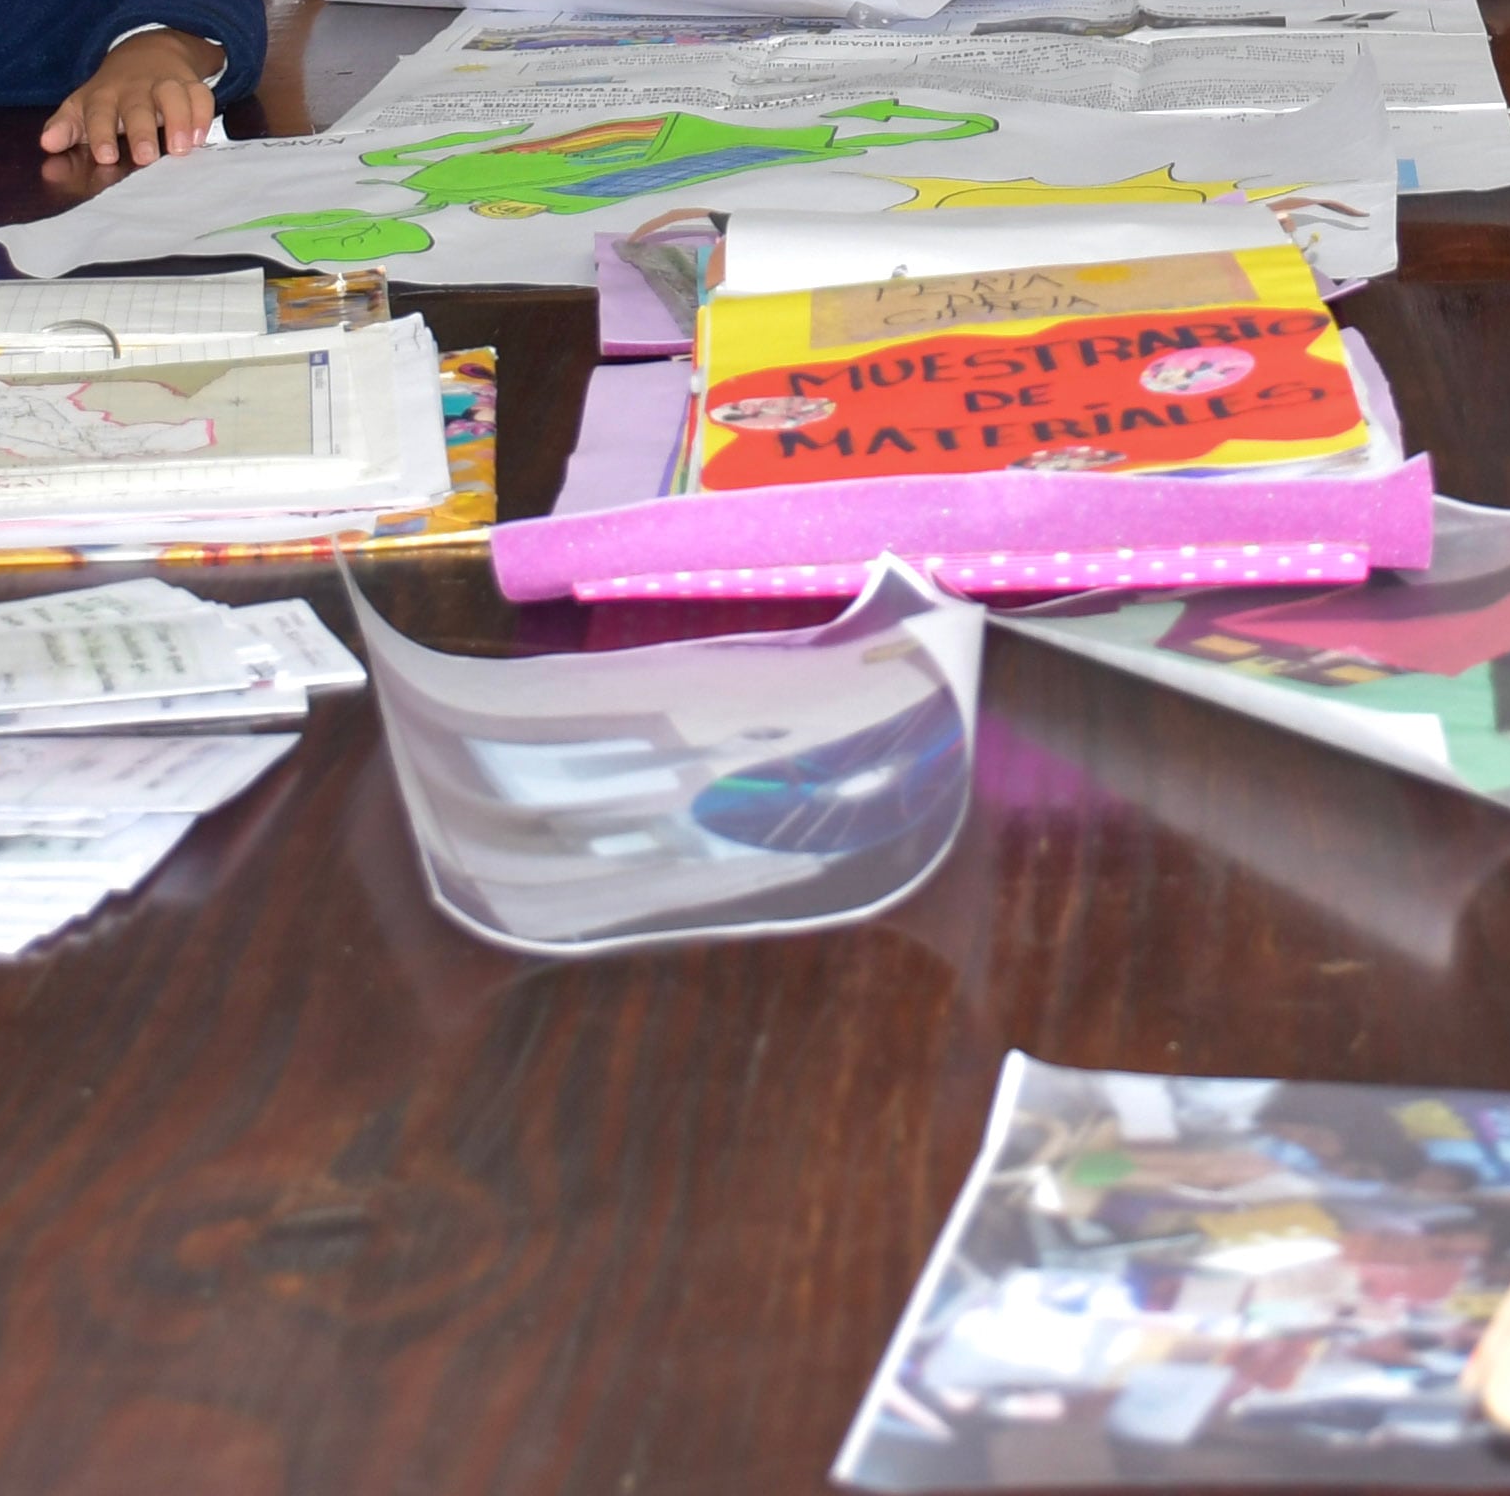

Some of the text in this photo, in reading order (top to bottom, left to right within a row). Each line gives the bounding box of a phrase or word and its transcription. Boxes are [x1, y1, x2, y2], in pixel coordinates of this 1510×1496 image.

[788, 315, 1332, 396] MUESTRARIO
[778, 380, 1326, 458] MATERIALES
[964, 383, 1054, 413] DE
